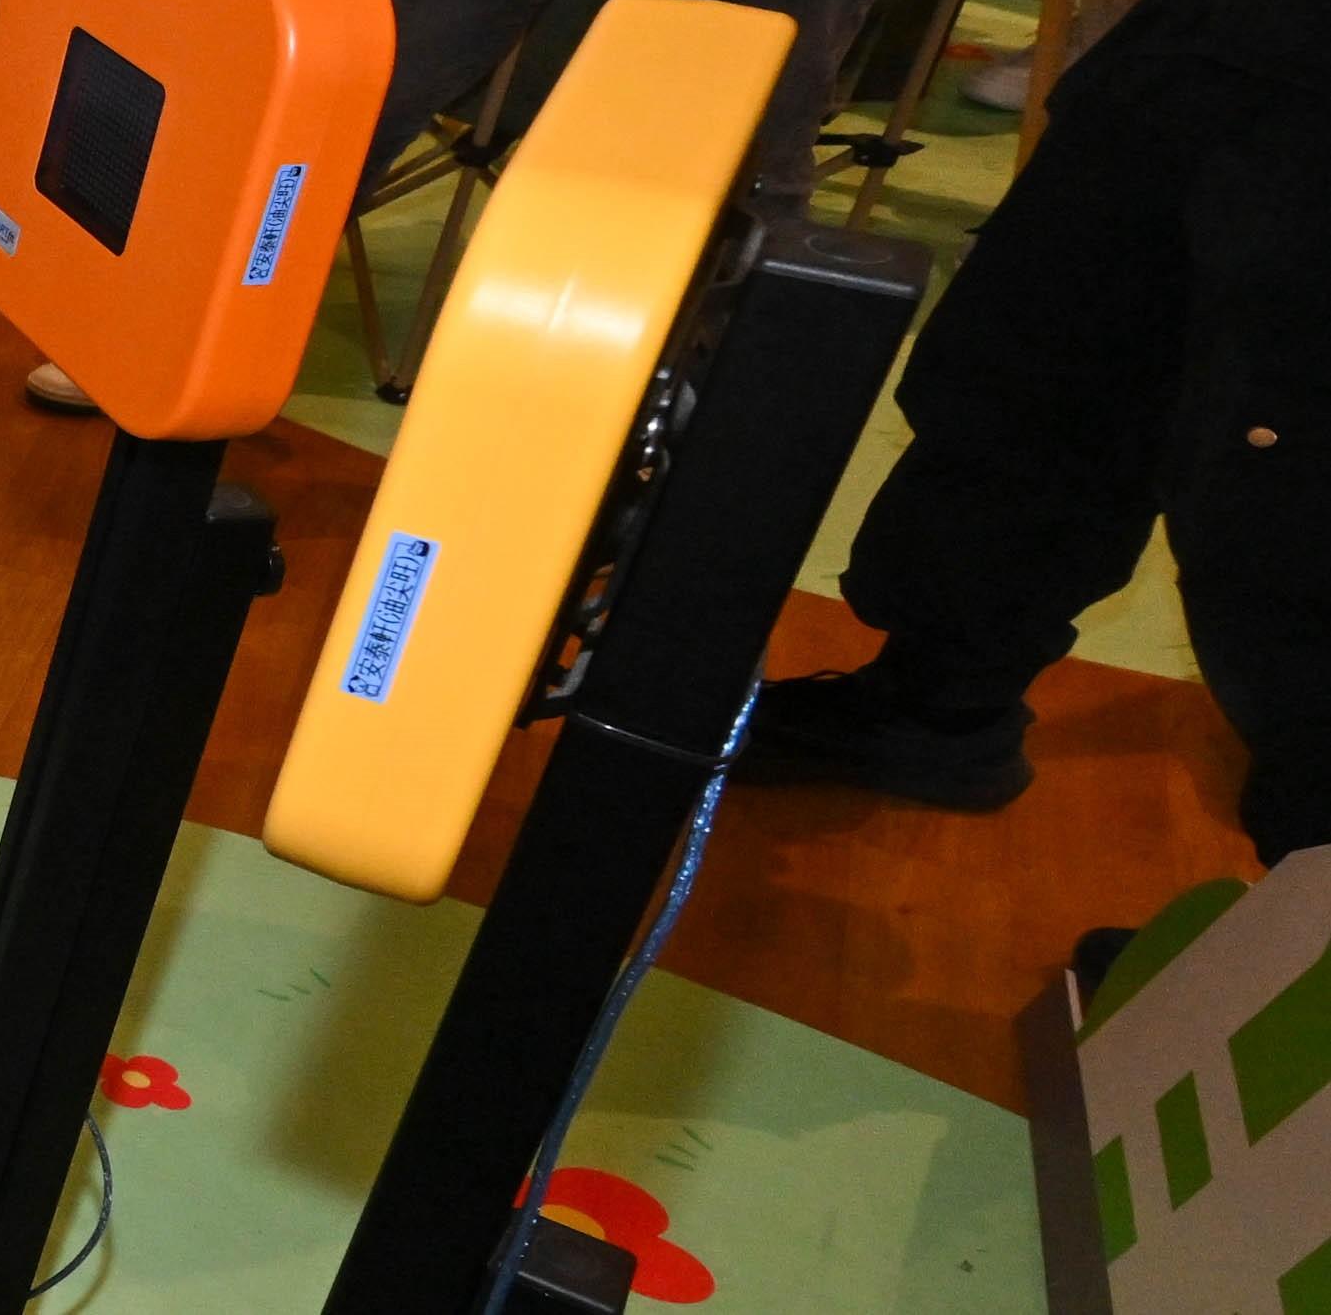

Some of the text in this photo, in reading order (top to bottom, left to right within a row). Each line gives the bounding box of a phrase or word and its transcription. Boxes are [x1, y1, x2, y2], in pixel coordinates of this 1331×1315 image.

[356, 554, 422, 678] 安泰軒(油尖旺)
